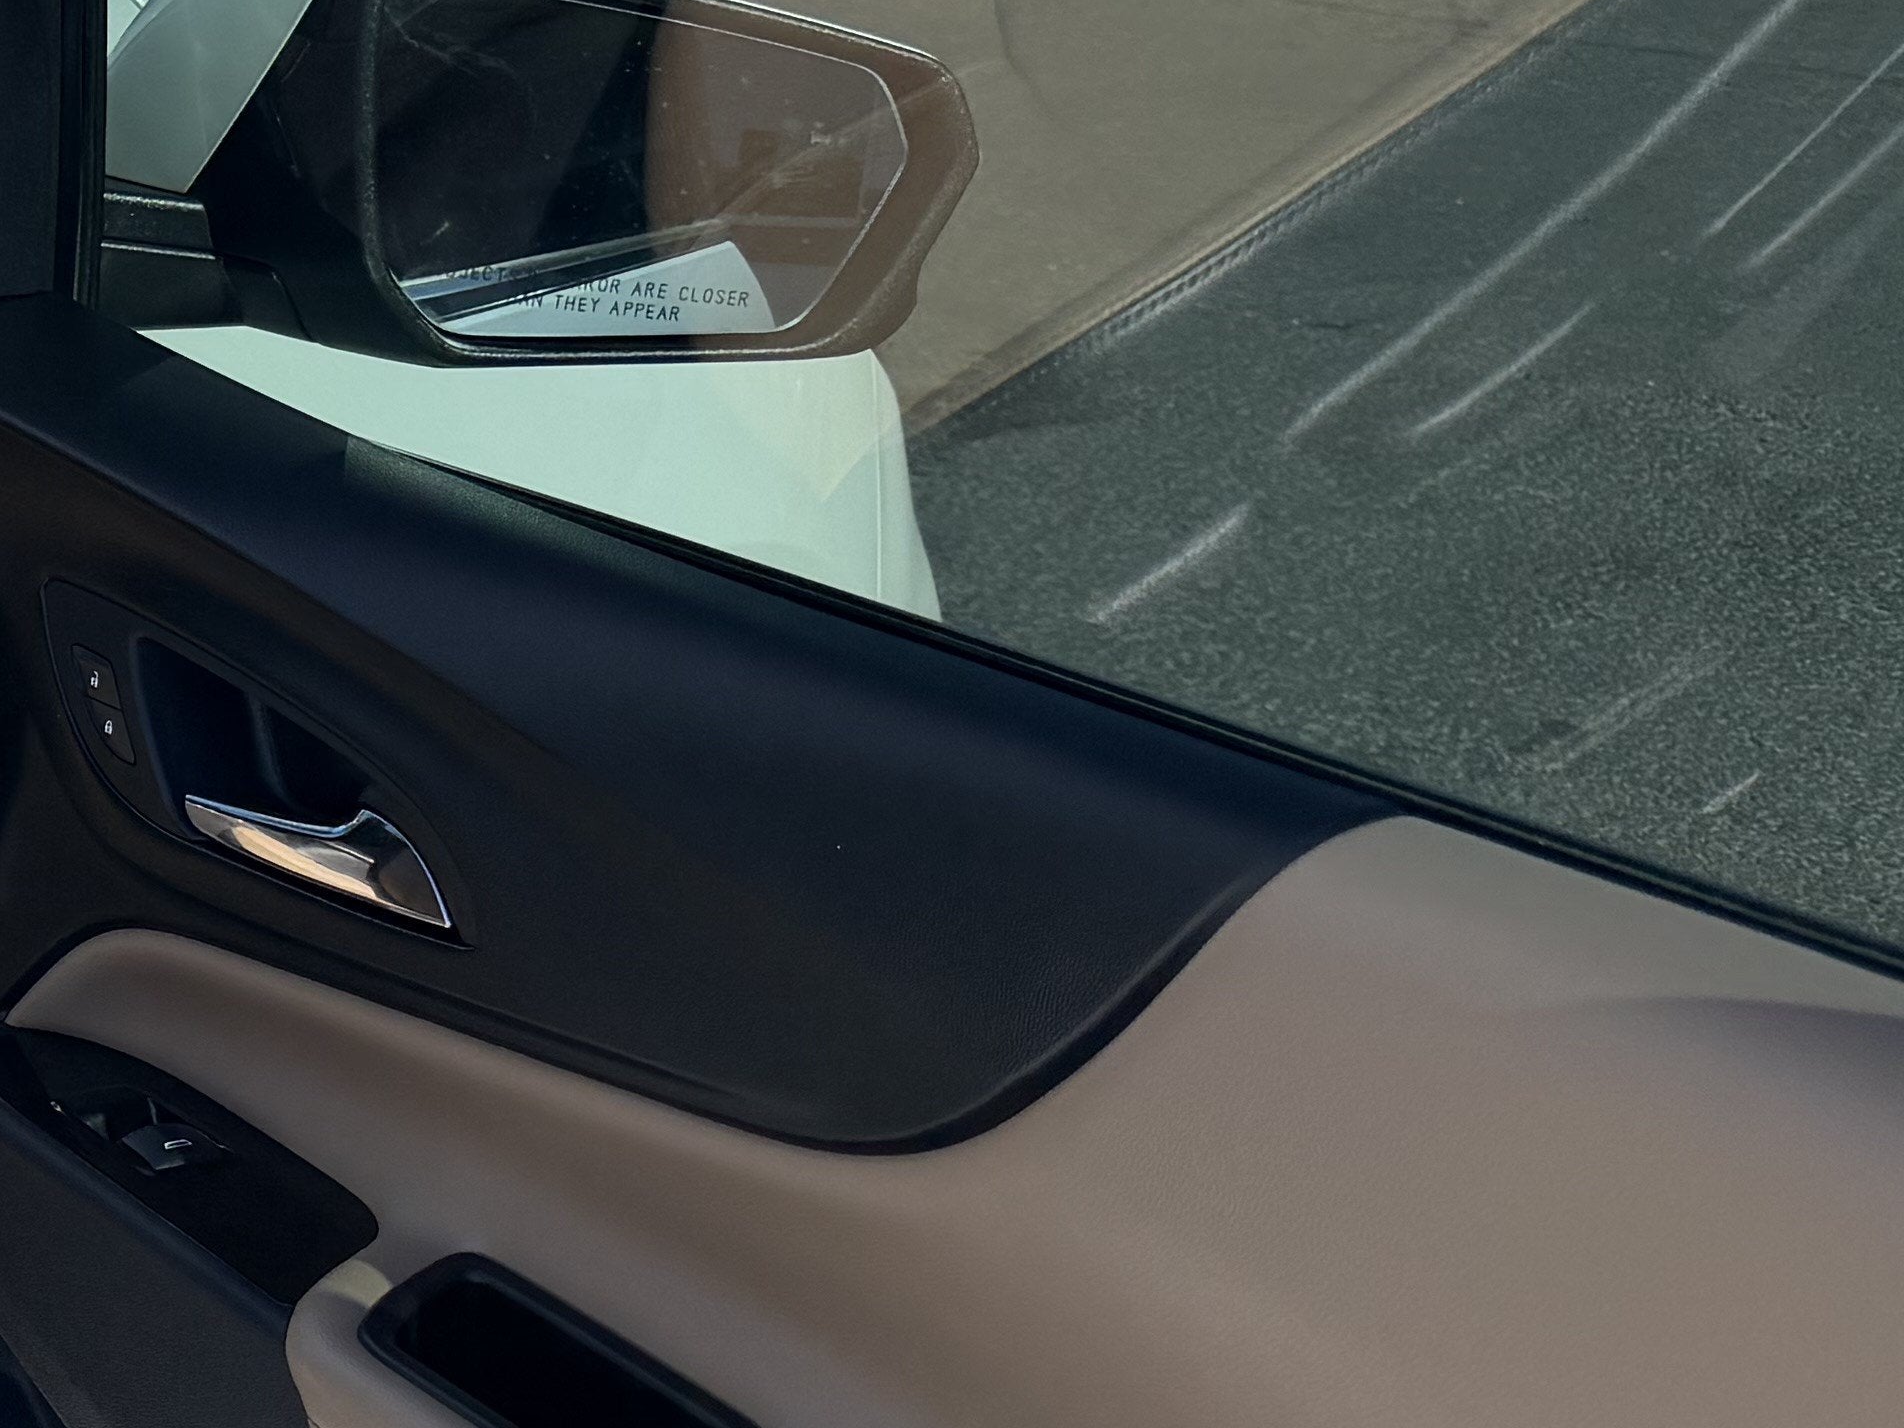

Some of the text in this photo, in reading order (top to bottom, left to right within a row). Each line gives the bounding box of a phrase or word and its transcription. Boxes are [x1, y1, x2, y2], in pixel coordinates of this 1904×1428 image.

[554, 294, 601, 314] THEY
[608, 300, 681, 323] APPEAR
[630, 280, 669, 300] ARE
[678, 284, 750, 309] CLOSER
